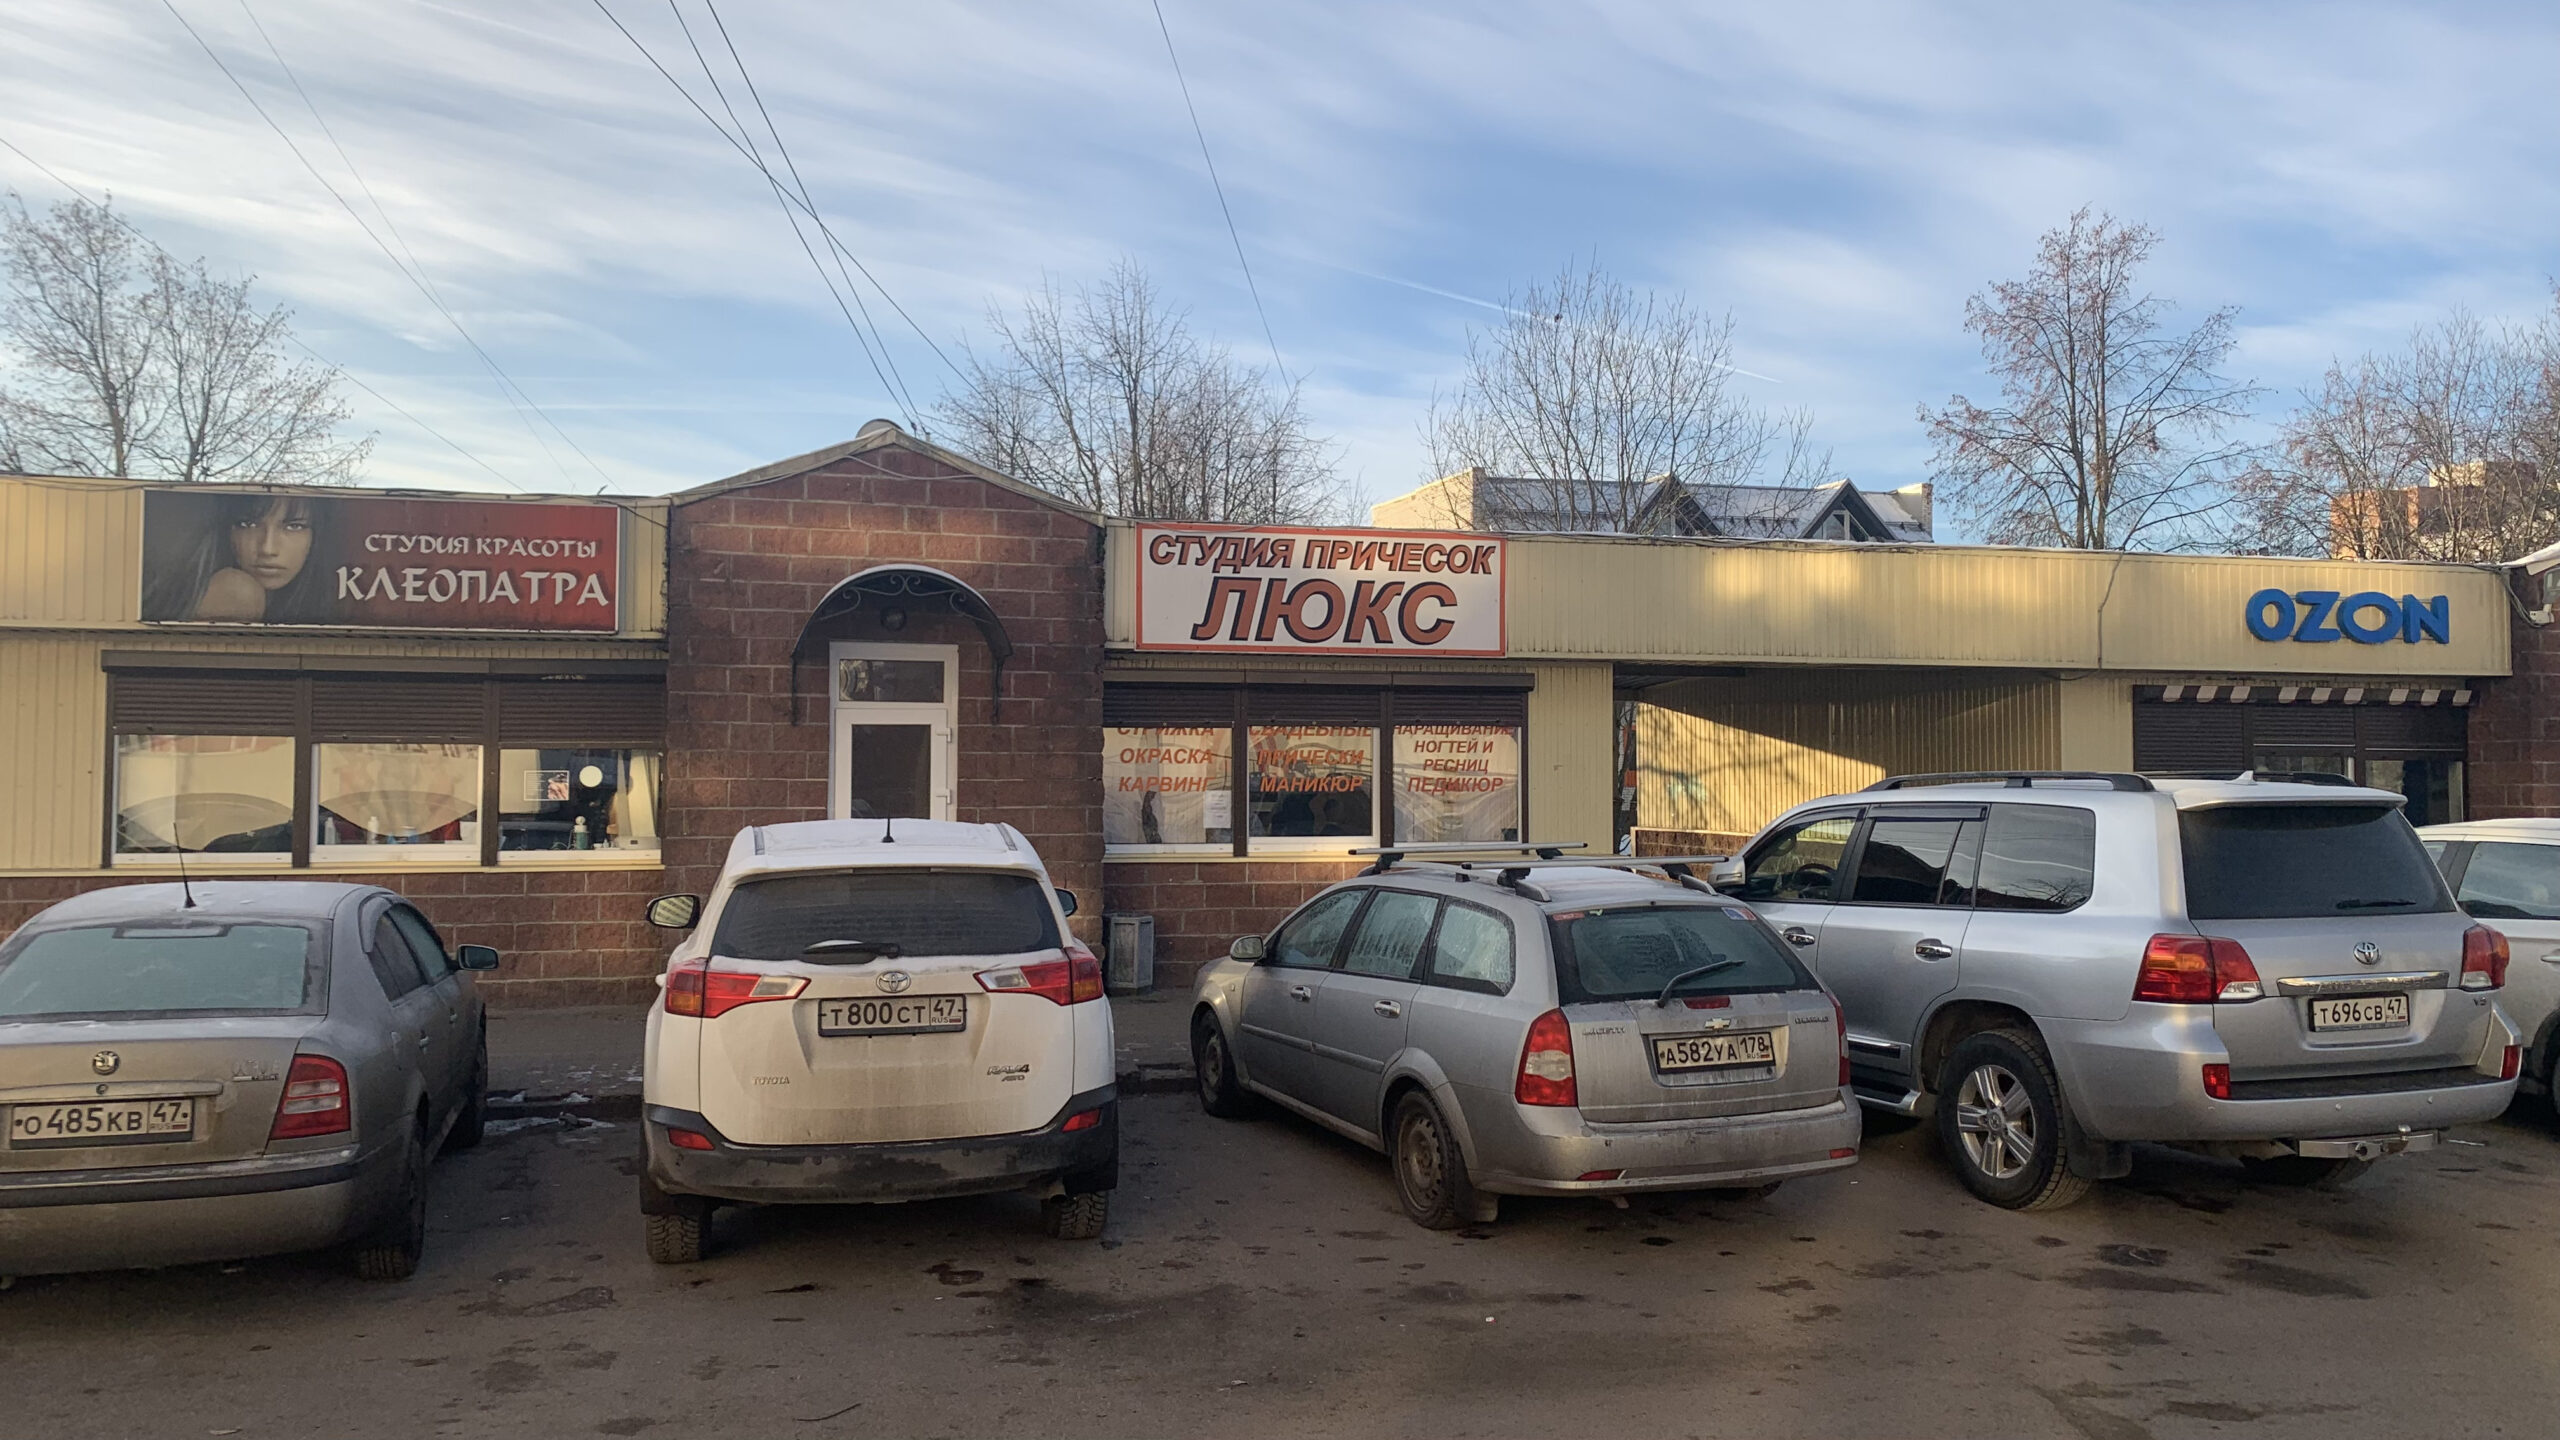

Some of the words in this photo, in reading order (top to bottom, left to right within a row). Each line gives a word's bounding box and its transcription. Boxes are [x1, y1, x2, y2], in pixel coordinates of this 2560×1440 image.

[364, 533, 469, 554] СТУДИЯ
[476, 537, 597, 559] КРАСОТЫ
[1149, 534, 1296, 574] СТУДИЯ
[1302, 538, 1497, 575] ПРИЧЕСОК
[335, 565, 609, 607] КЛЕОПАТРА
[1190, 575, 1458, 646] ЛЮКС
[2245, 588, 2450, 645] OZON
[1413, 738, 1479, 754] НОГТЕЙ
[1482, 741, 1494, 754] И
[1120, 747, 1213, 765] ОКРАСКА
[1257, 749, 1364, 766] ПРИЧЕСКИ
[1423, 758, 1489, 775] РЕСНИЦ
[1118, 776, 1217, 793] КАРВИНГ
[1260, 776, 1363, 793] МАНИКЮР
[1408, 776, 1504, 797] ПЕДИКЮР
[933, 999, 956, 1017] 47
[2387, 998, 2402, 1015] 47
[1740, 1036, 1766, 1054] 178
[152, 1102, 182, 1123] 47
